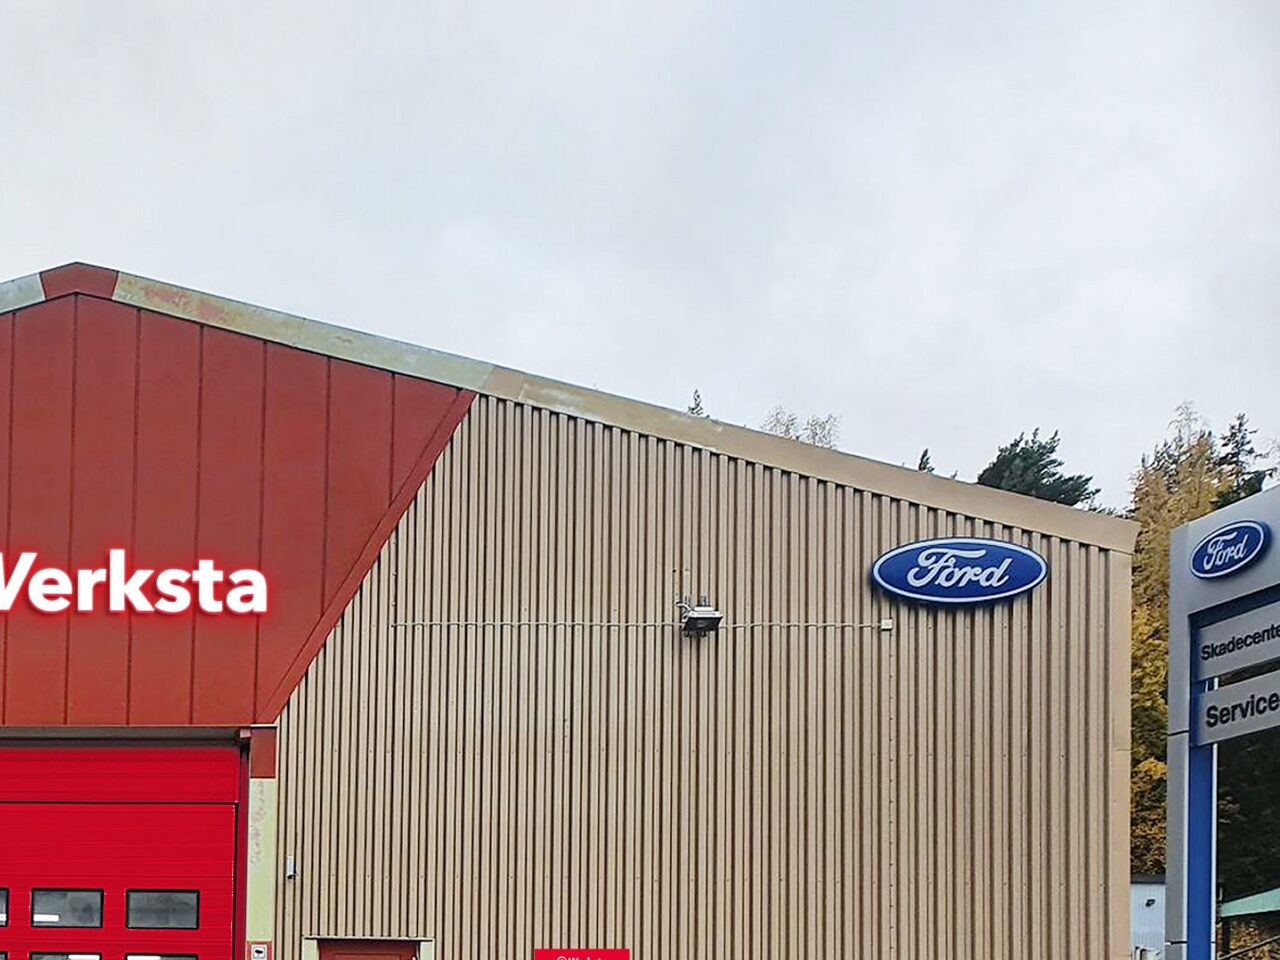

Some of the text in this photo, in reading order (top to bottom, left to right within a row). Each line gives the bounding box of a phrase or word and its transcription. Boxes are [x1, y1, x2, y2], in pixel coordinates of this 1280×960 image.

[907, 548, 1013, 587] Ford
[1203, 531, 1248, 571] Ford
[1206, 692, 1280, 728] Service
